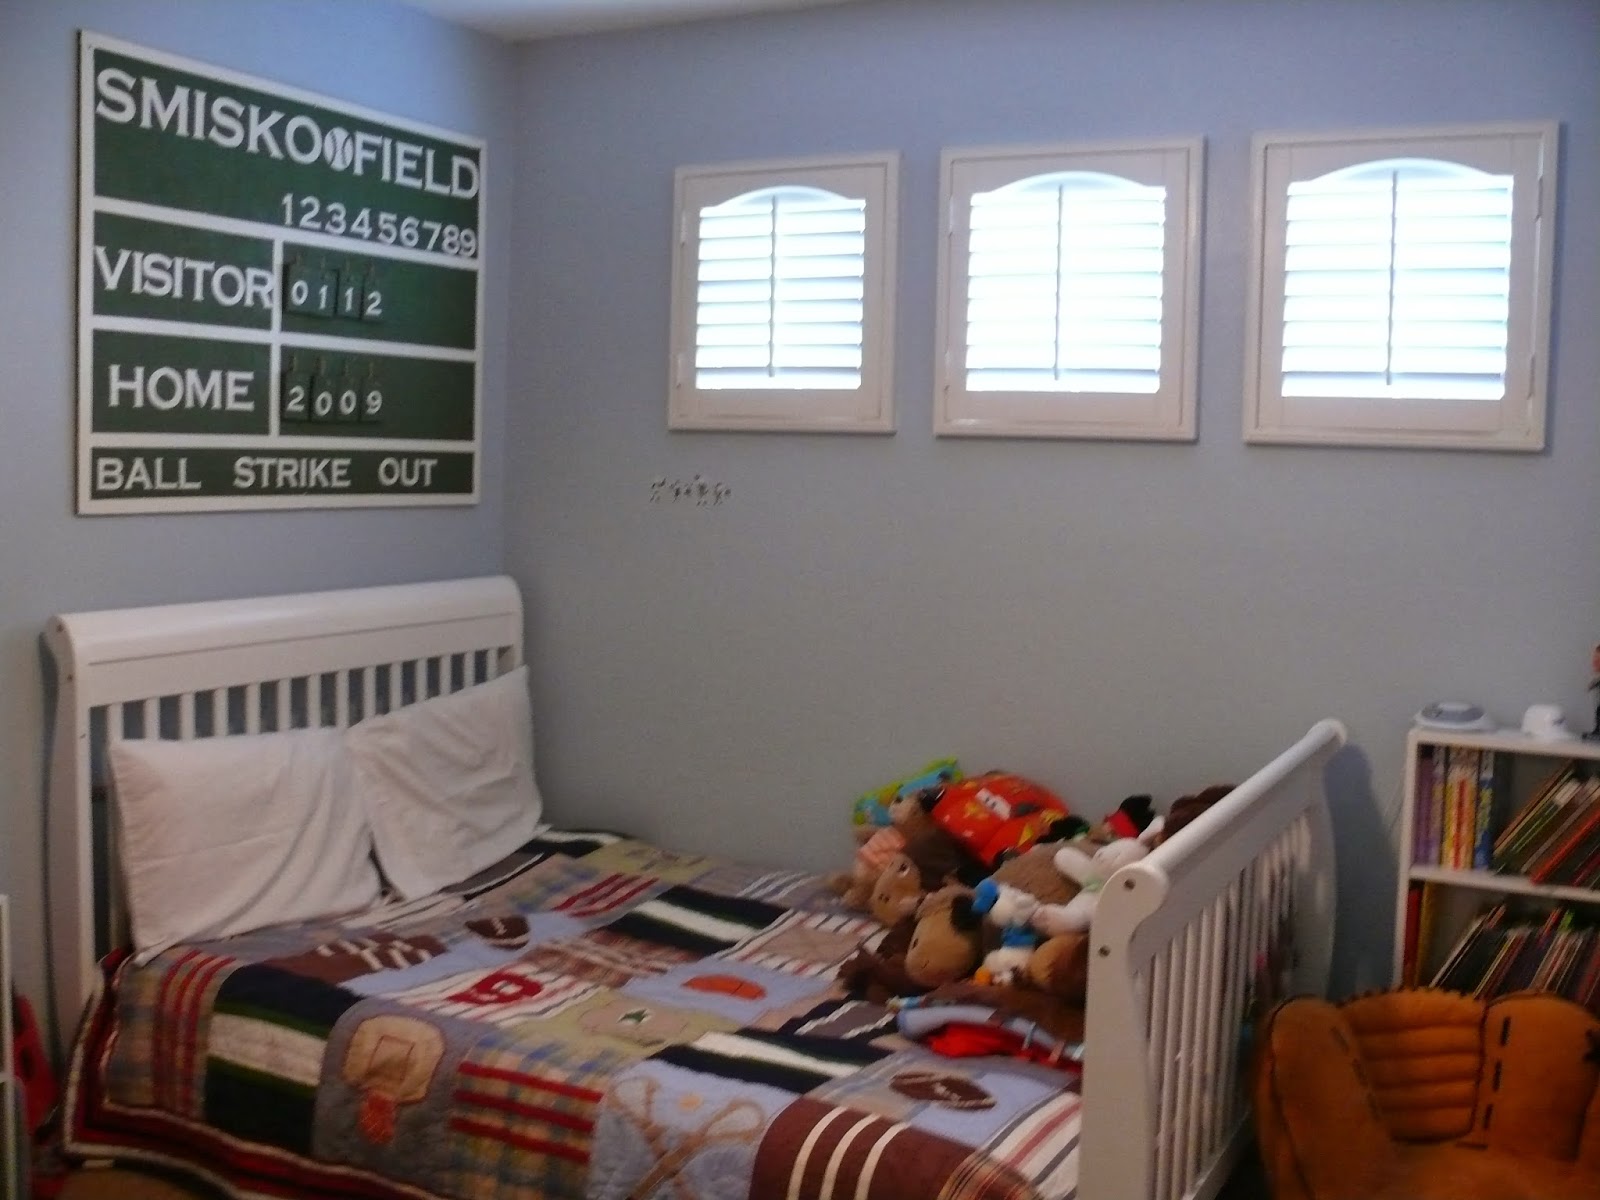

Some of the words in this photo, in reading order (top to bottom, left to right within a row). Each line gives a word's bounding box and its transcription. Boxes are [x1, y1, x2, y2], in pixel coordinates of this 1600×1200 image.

[96, 68, 321, 164] SMISKO
[353, 131, 480, 200] FIELD
[94, 245, 274, 308] VISITOR
[108, 364, 255, 411] HOME
[96, 456, 201, 491] BALL
[233, 456, 352, 488] STRIKE
[378, 457, 438, 487] OUT
